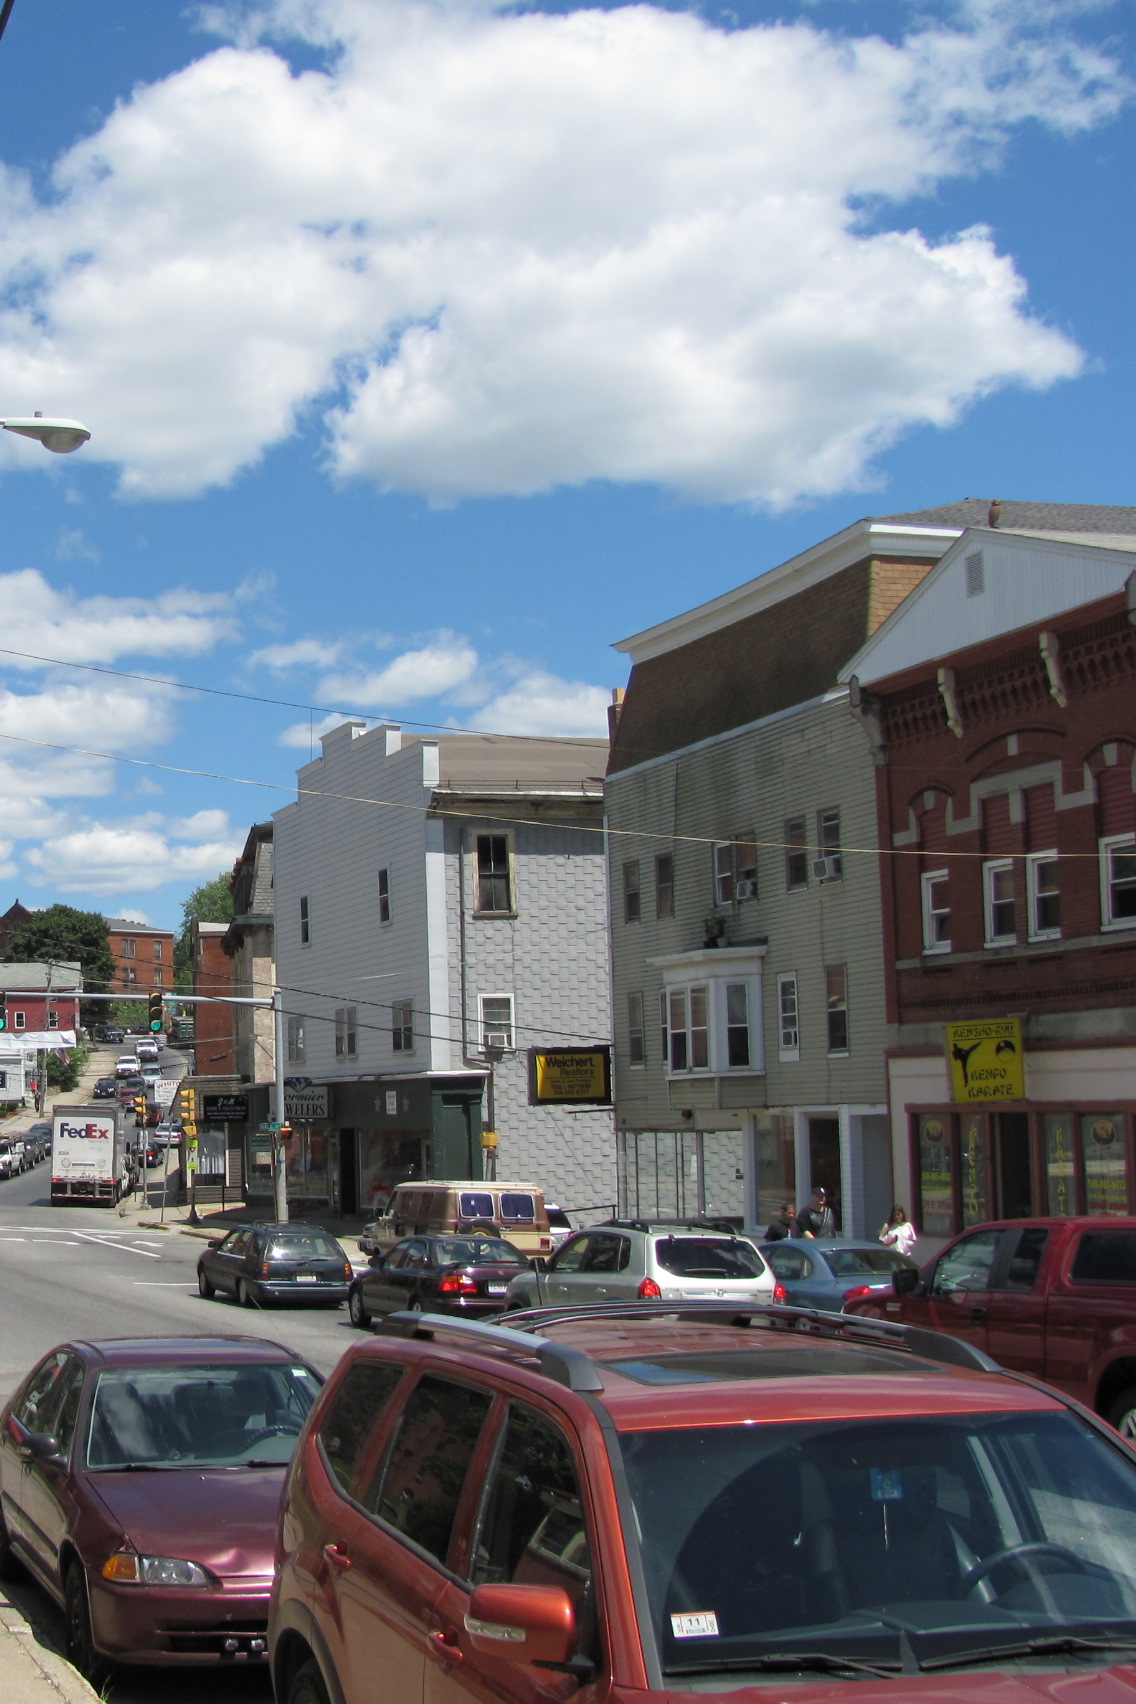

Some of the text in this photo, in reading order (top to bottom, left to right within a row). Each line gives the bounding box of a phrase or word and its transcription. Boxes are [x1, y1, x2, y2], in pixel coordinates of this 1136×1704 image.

[560, 1067, 594, 1076] Realtors
[284, 1091, 325, 1101] ormier
[968, 1083, 1014, 1098] KARATE
[284, 1103, 325, 1116] WELERS
[60, 1122, 110, 1139] FedEx
[1056, 1127, 1066, 1217] KARAT
[687, 1618, 700, 1626] 11
